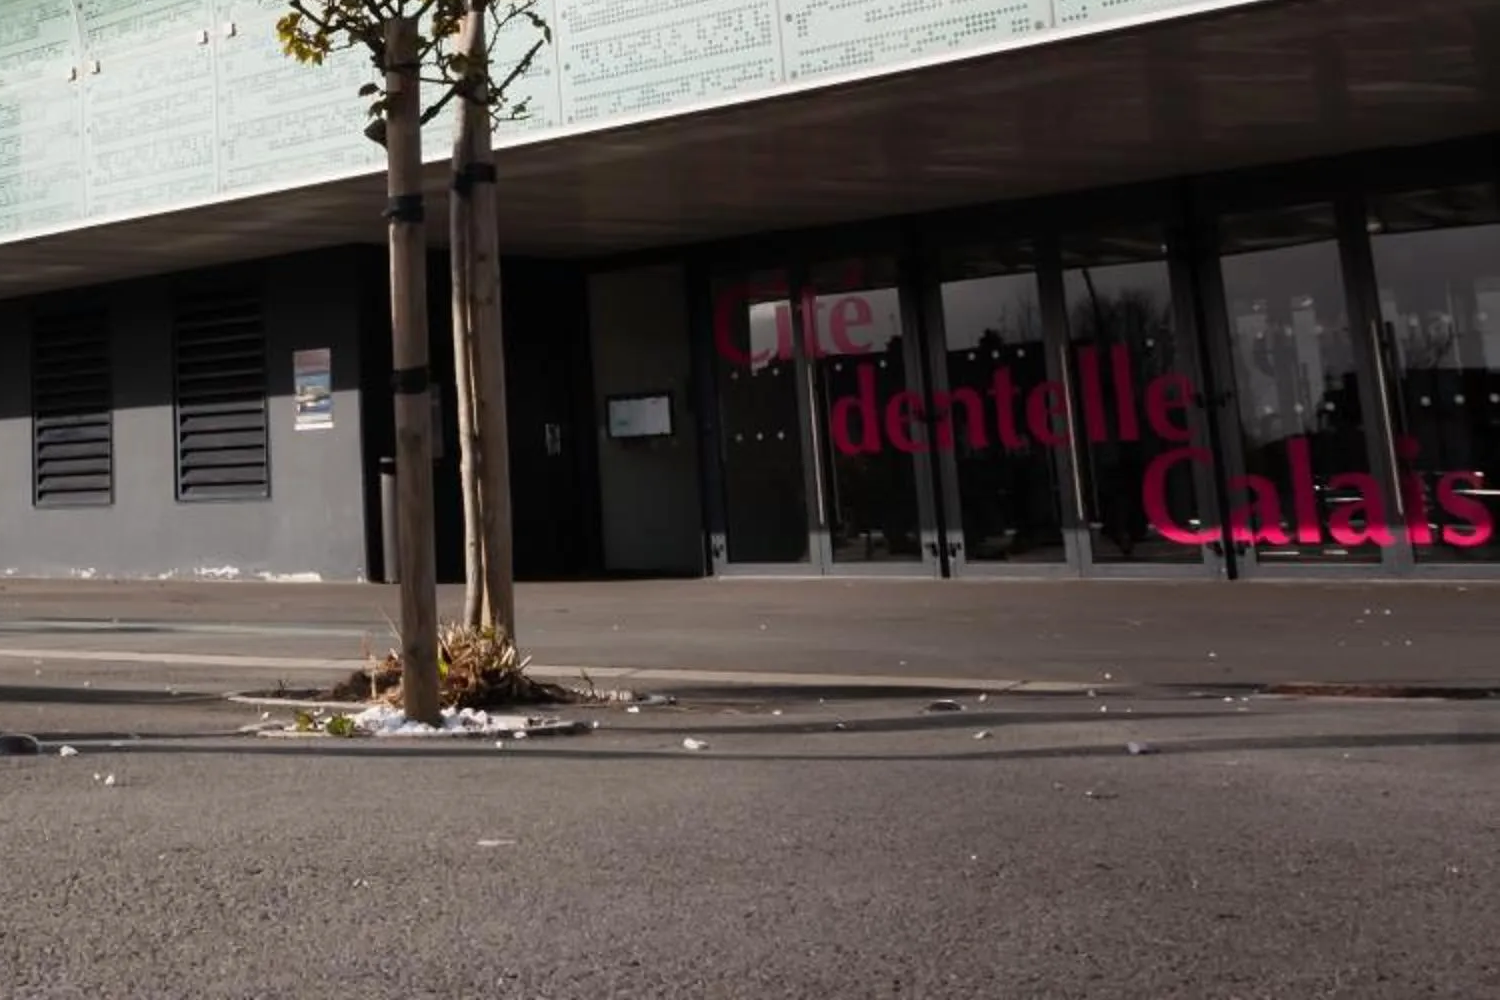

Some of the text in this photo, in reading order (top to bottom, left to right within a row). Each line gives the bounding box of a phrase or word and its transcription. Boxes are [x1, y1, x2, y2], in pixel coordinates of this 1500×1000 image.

[713, 260, 873, 364] Cité
[831, 342, 1197, 456] dentelle
[1141, 433, 1495, 547] Calais
